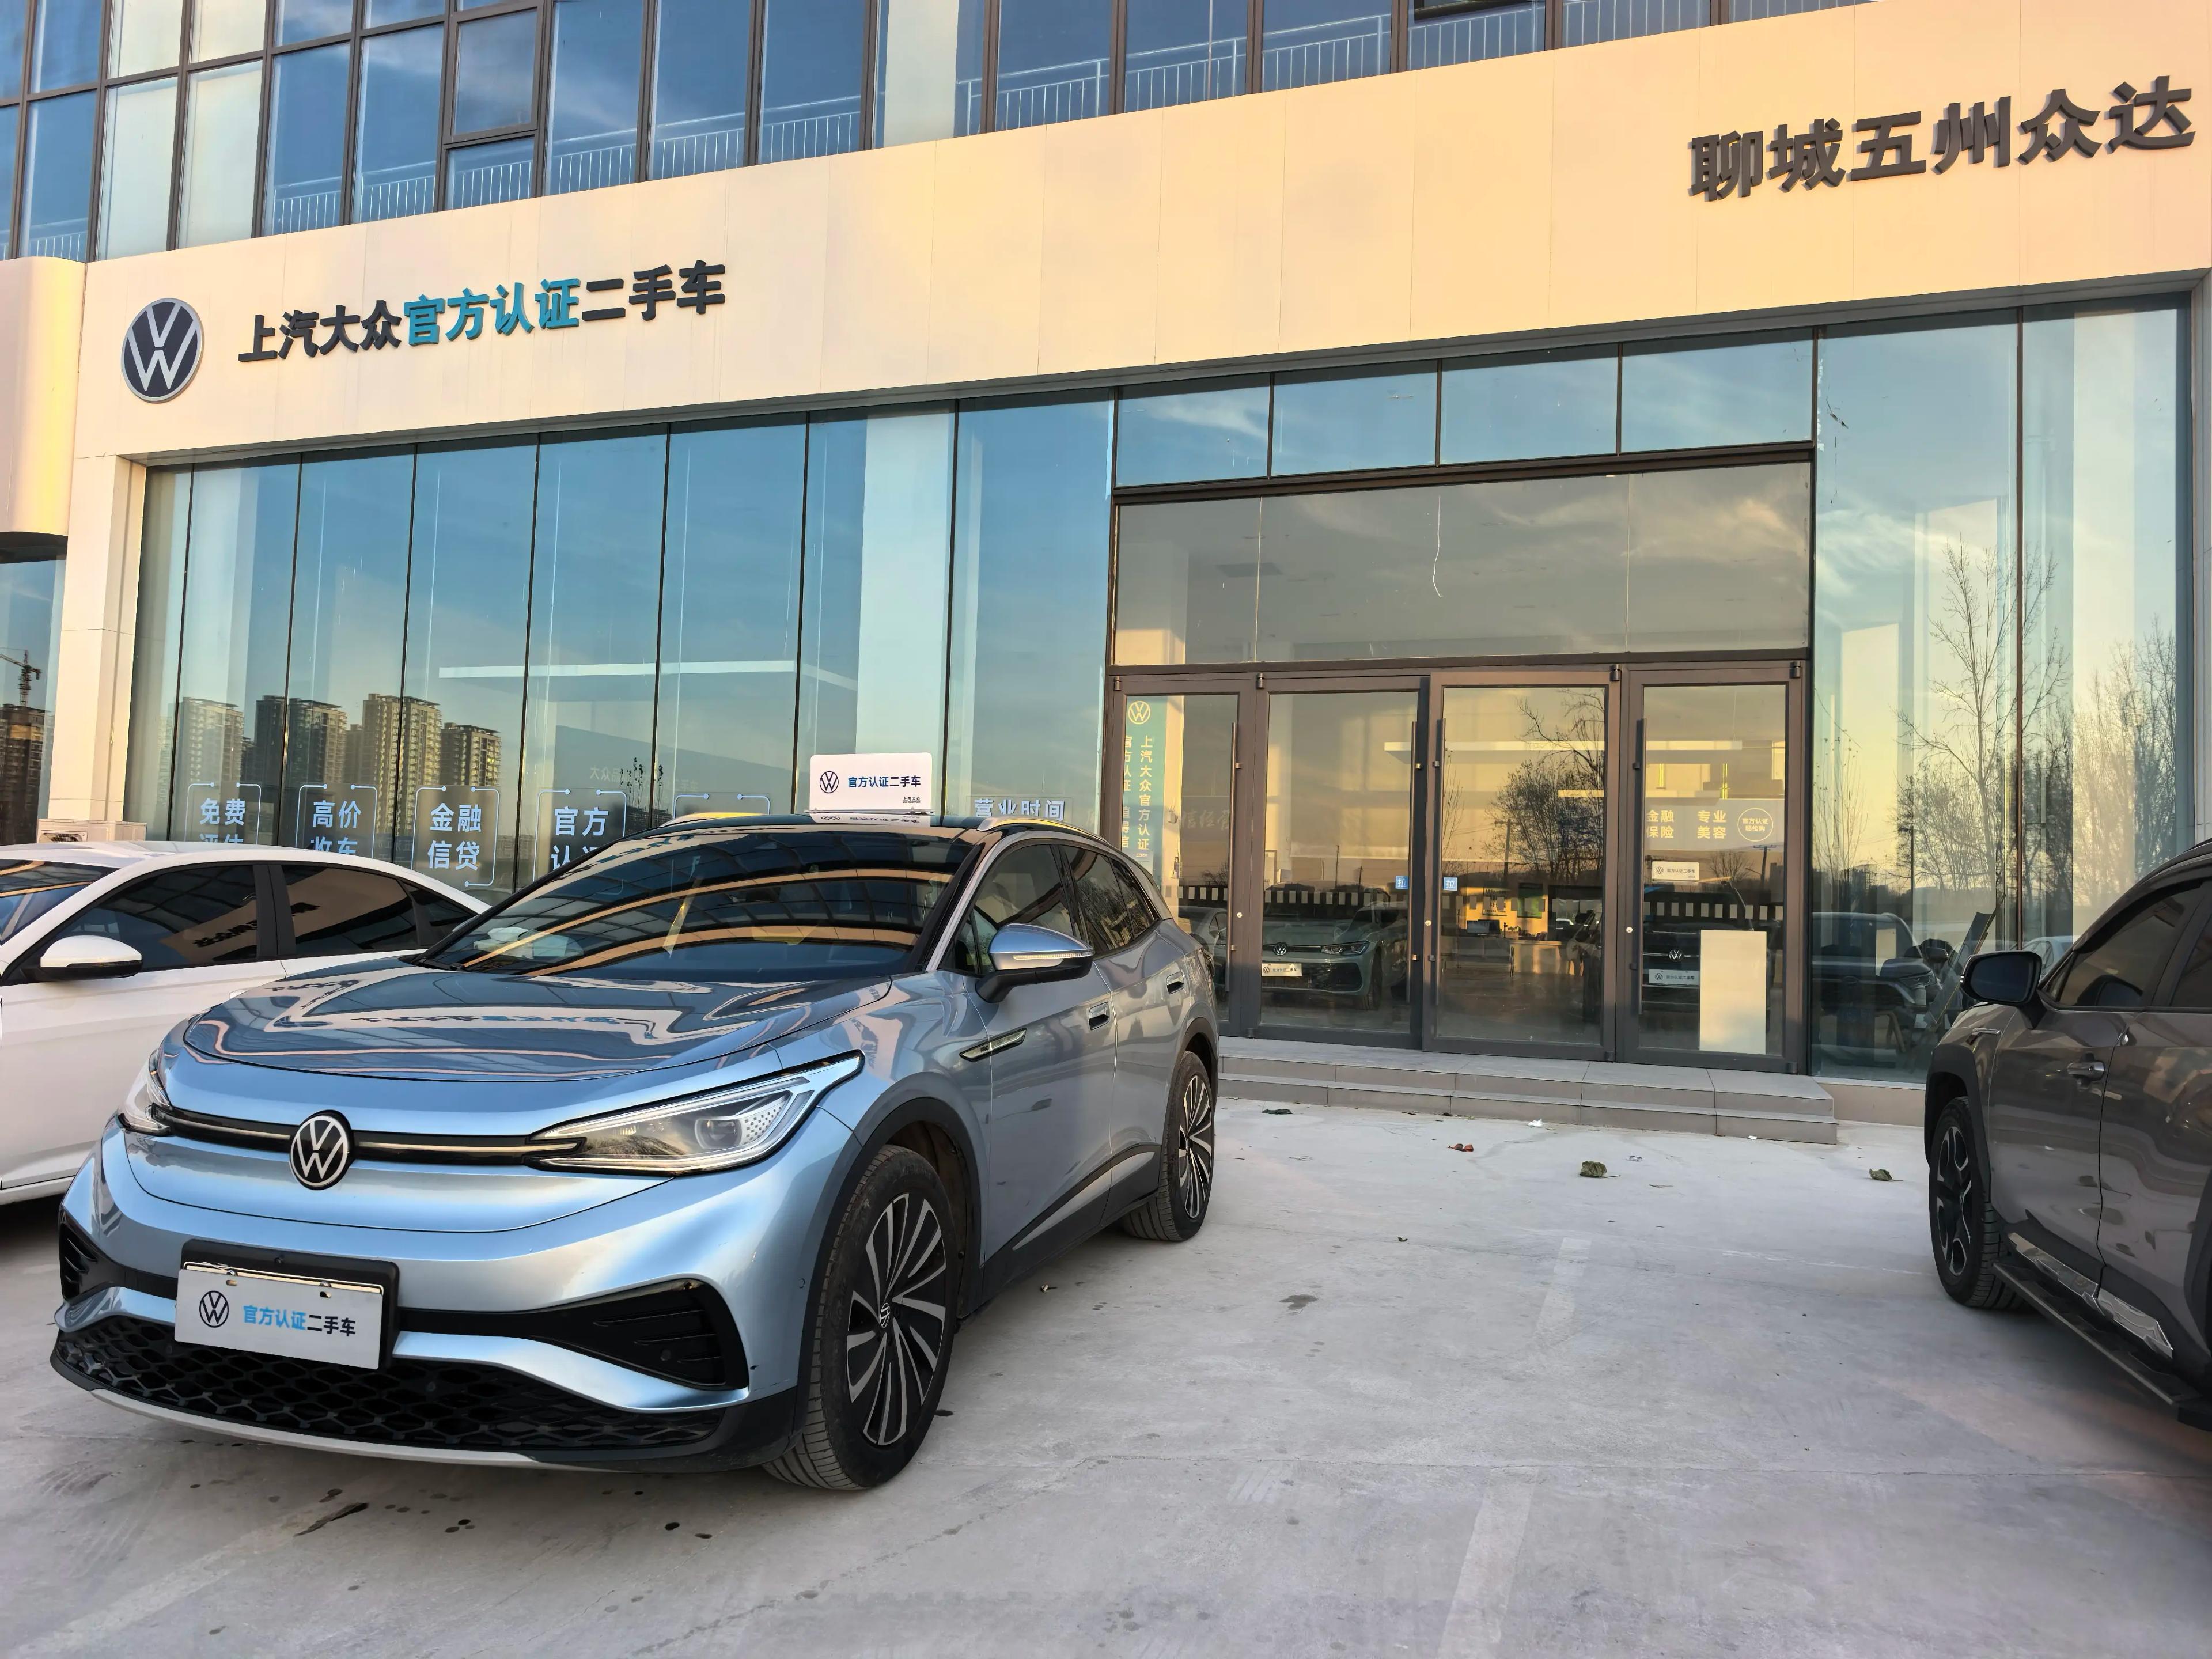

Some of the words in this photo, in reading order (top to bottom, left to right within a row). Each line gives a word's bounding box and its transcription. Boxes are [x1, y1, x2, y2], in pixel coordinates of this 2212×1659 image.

[1688, 75, 2196, 202] 聊城五州众达
[238, 260, 726, 362] 上汽大众官方认证二手车
[848, 775, 921, 788] 官方认证二手车
[1138, 735, 1153, 850] 上汽大众官方认证
[200, 798, 246, 826] 免费
[313, 800, 362, 828] 高价
[430, 802, 482, 833] 金融
[555, 806, 609, 836] 官方
[974, 798, 1065, 821] 营业时间
[1646, 810, 1674, 823] 金融
[1697, 810, 1727, 823] 专业
[1646, 825, 1674, 839] 保险
[1697, 825, 1727, 839] 美容
[427, 840, 480, 871] 信贷
[551, 845, 599, 870] 认
[1445, 879, 1455, 888] 拉
[243, 1305, 356, 1337] 官方认证二手车
